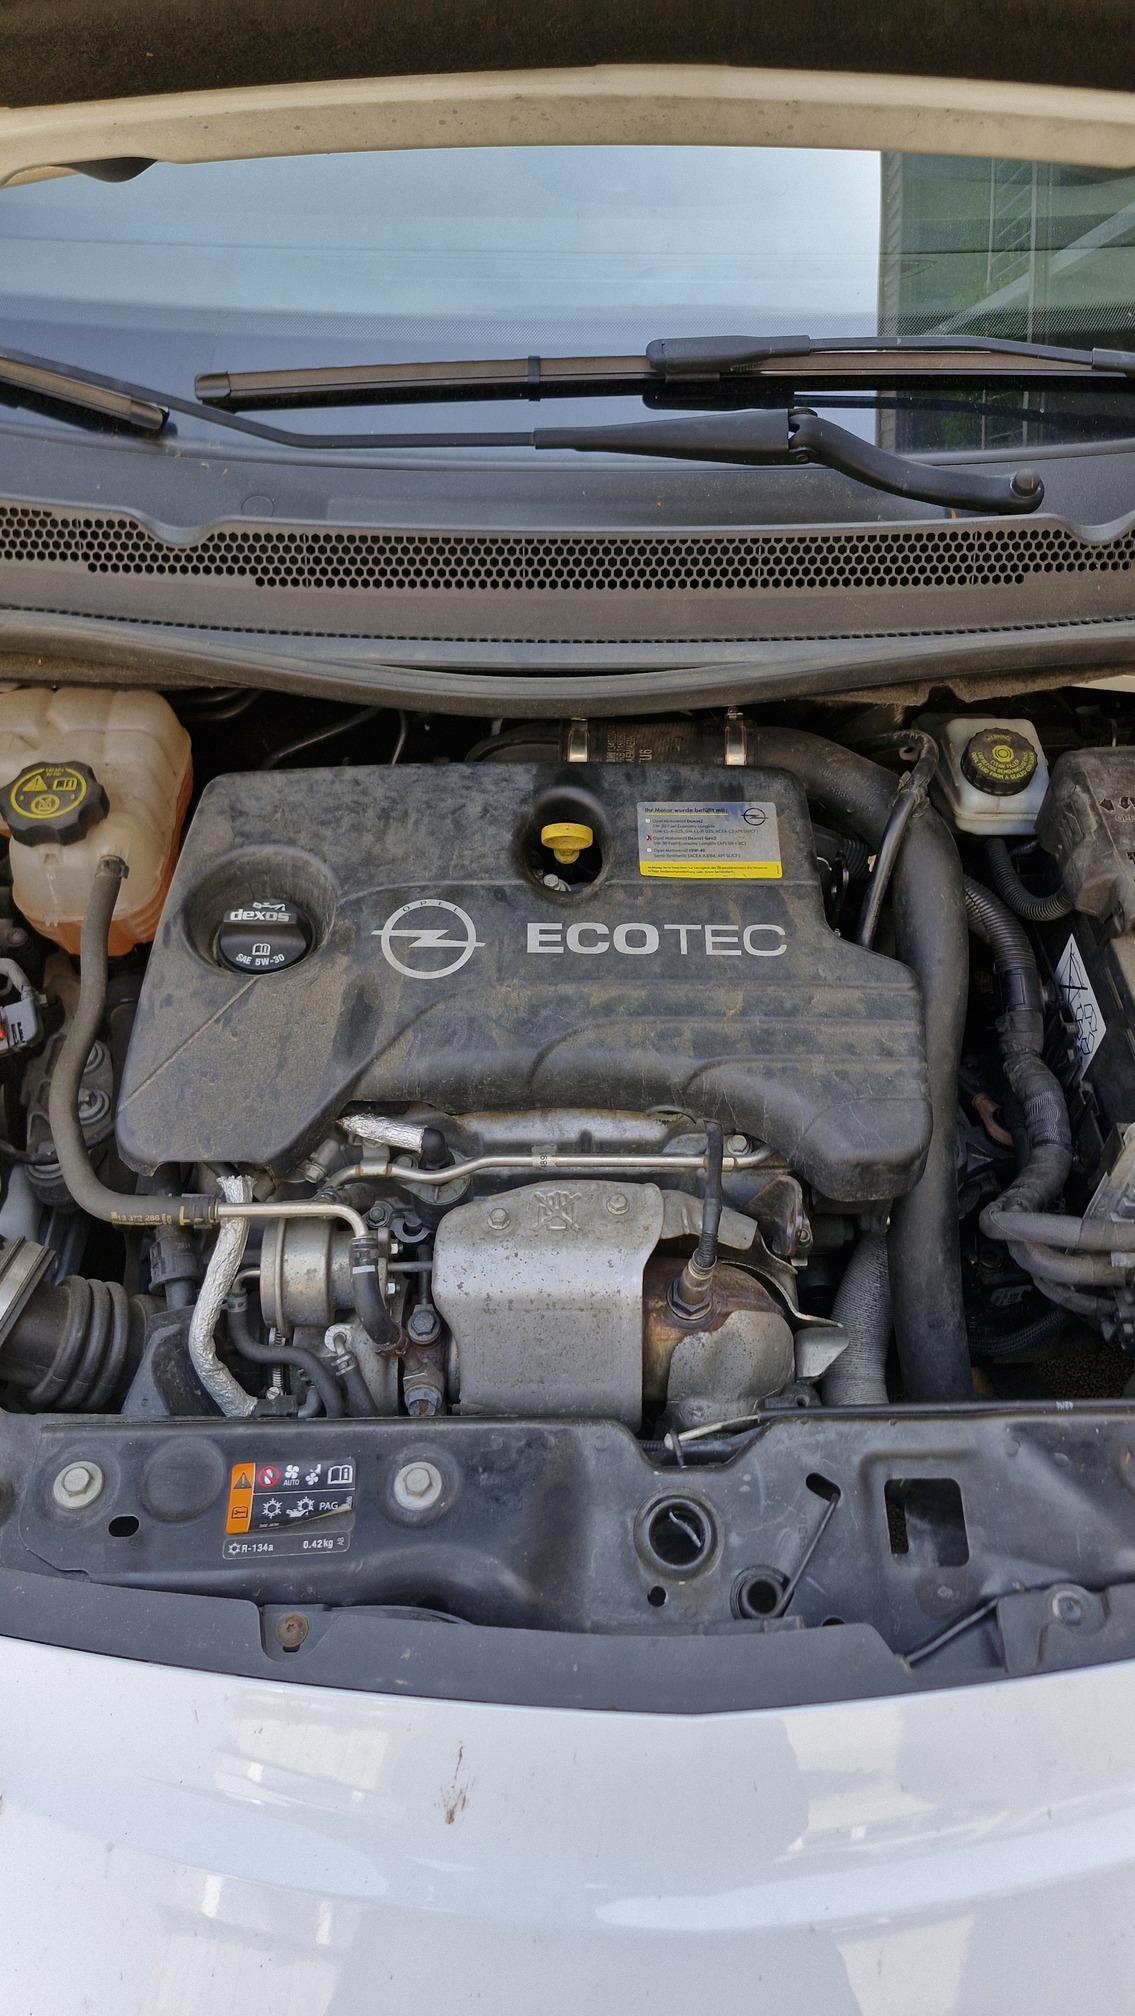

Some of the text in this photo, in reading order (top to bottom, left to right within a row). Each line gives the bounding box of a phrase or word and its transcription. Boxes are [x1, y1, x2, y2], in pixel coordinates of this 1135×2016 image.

[230, 908, 291, 922] dexos
[526, 922, 788, 957] ECOTEC
[235, 953, 285, 966] SAE 5W-30
[319, 1501, 339, 1511] PAG
[241, 1543, 274, 1553] R-134a
